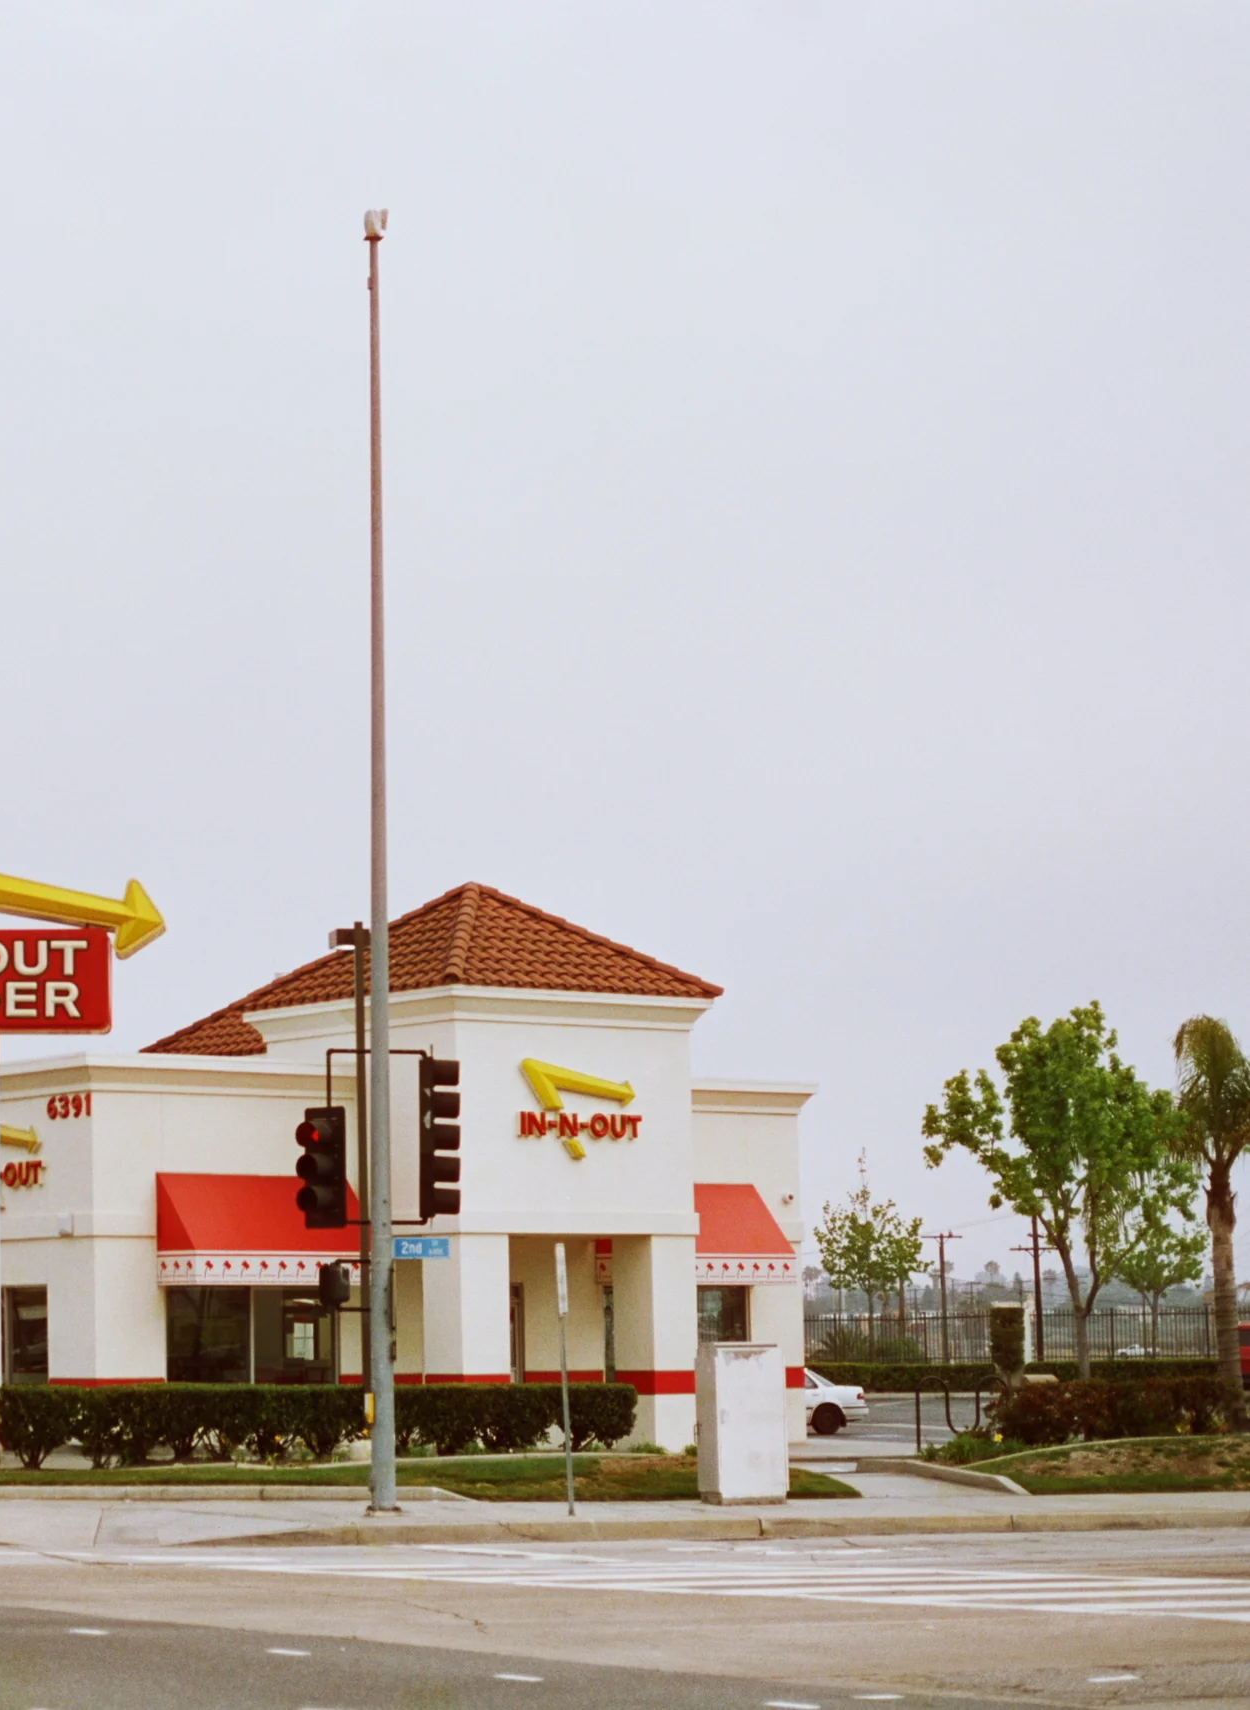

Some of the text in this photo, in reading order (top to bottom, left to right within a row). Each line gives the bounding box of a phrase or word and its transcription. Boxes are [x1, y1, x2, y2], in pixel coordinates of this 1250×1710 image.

[46, 1092, 92, 1120] 6391
[519, 1111, 643, 1138] IN-N-OUT
[401, 1241, 423, 1255] 2nd
